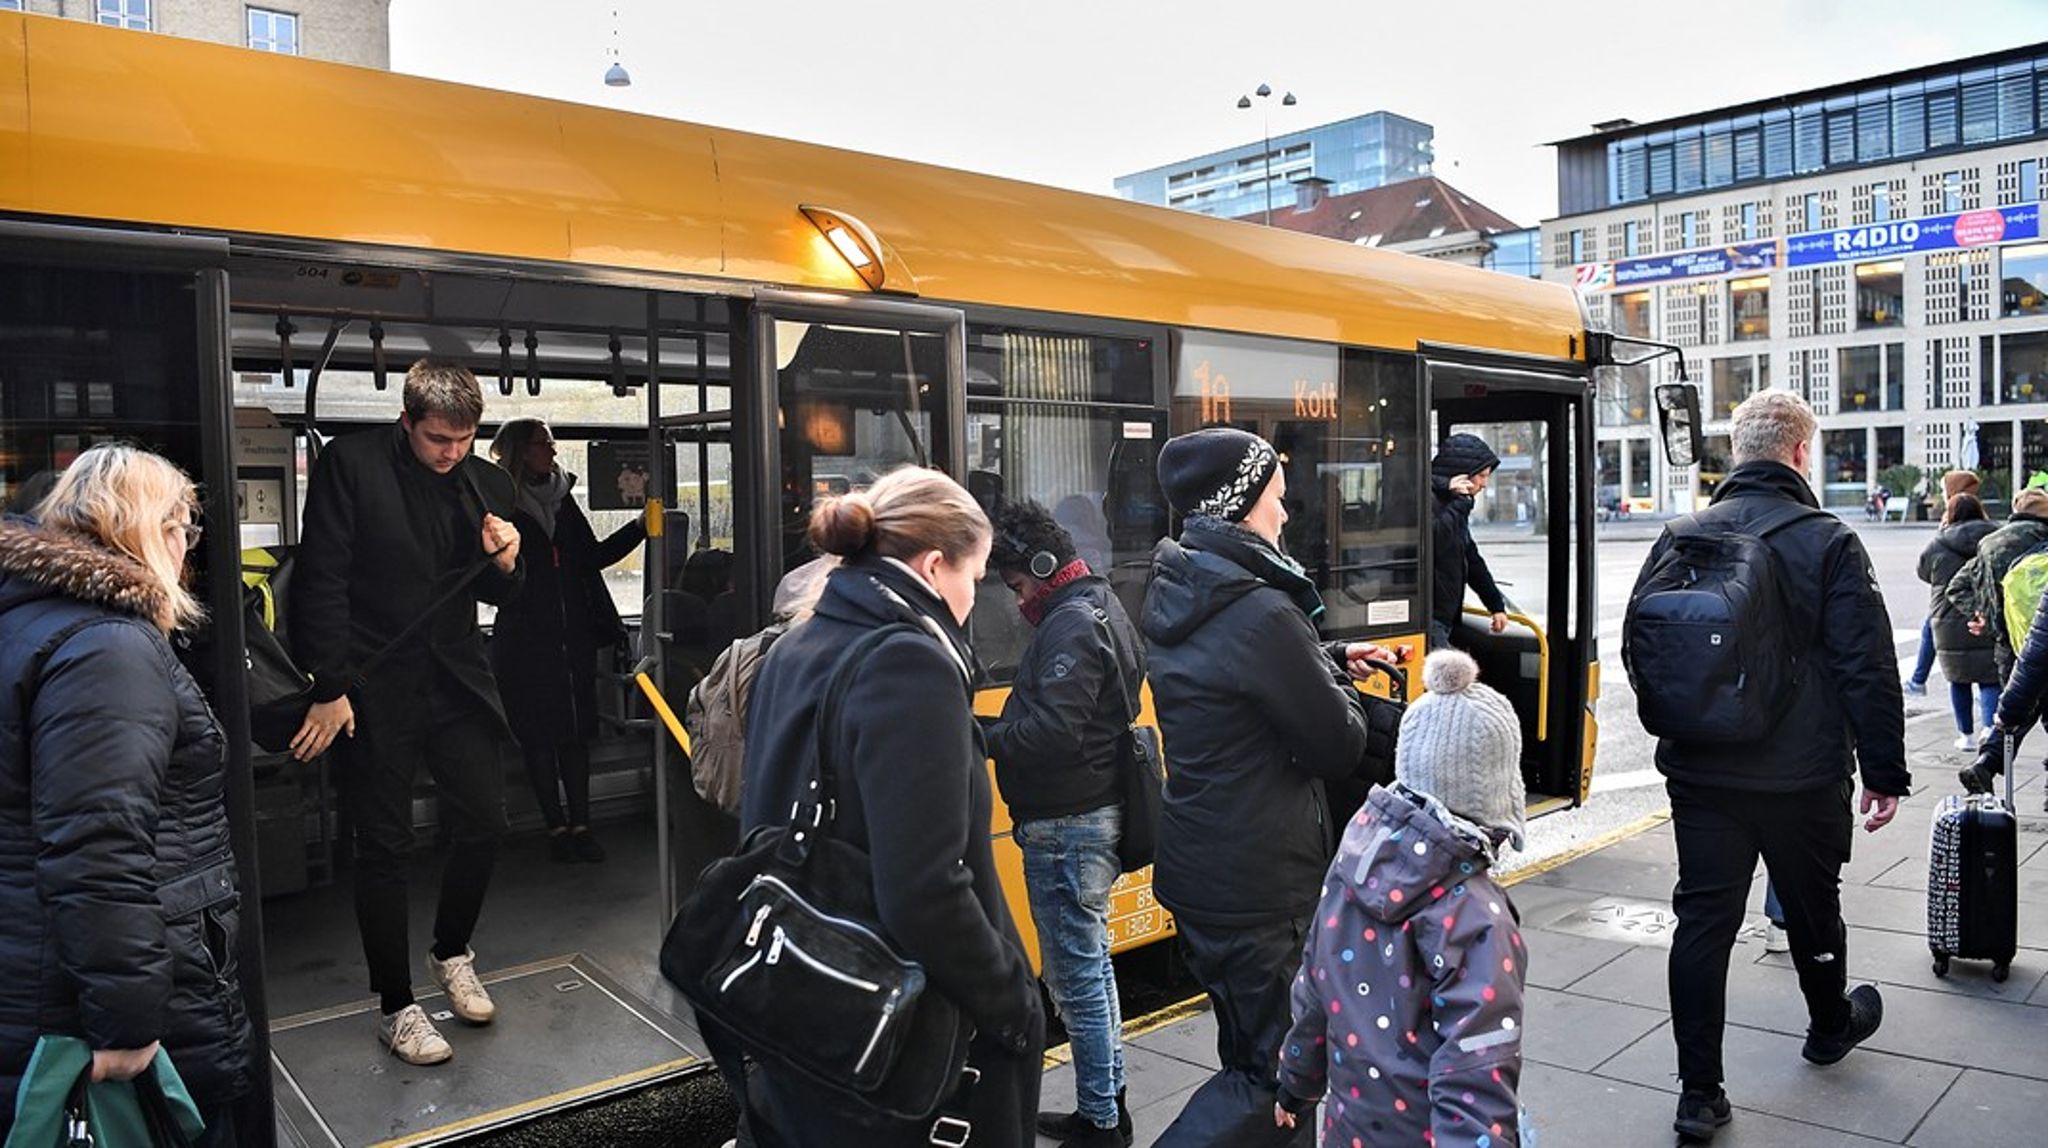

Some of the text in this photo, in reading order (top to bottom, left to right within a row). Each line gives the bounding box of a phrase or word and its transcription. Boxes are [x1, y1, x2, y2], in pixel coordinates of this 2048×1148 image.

[1833, 222, 1919, 251] R4DIO
[296, 266, 329, 279] 504
[1193, 359, 1338, 423] 1A Kolt
[1136, 887, 1153, 909] 89
